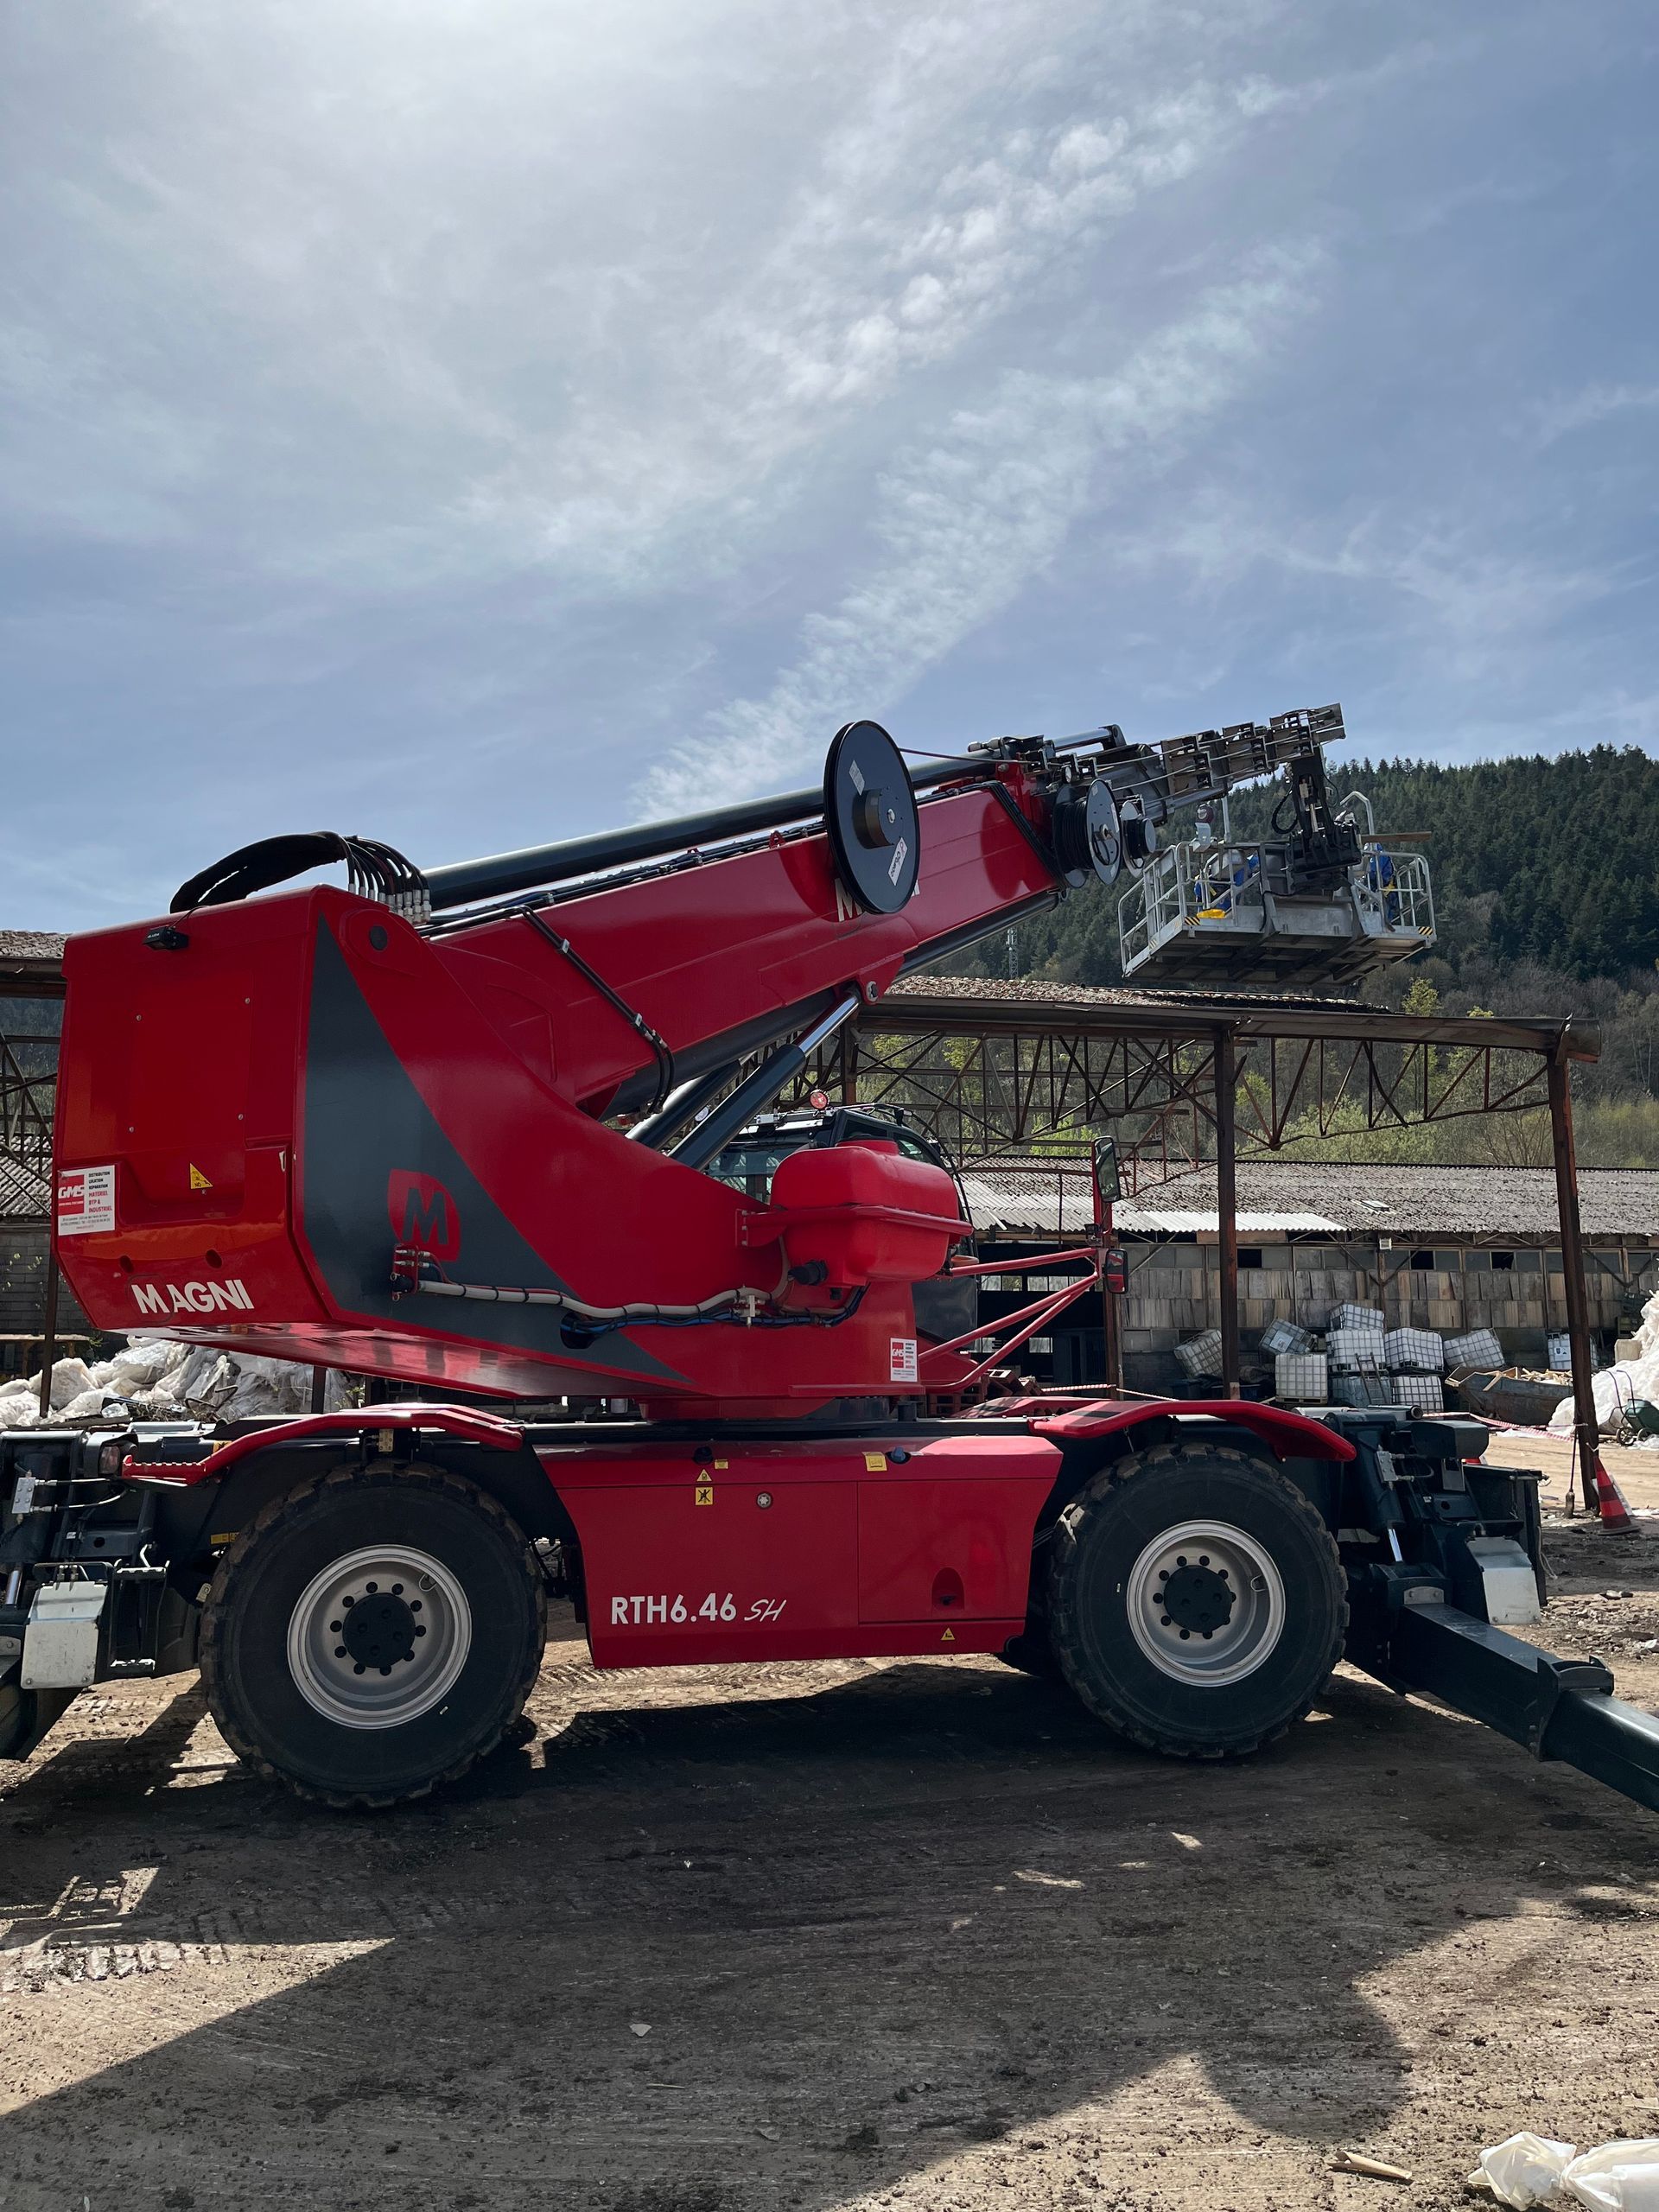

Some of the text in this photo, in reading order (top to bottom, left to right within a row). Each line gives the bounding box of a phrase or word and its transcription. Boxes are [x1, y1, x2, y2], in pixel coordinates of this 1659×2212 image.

[58, 1185, 85, 1199] GMS
[402, 1187, 448, 1245] M
[130, 1279, 255, 1314] MAGNI
[610, 1592, 788, 1626] RTH6.46 SH
